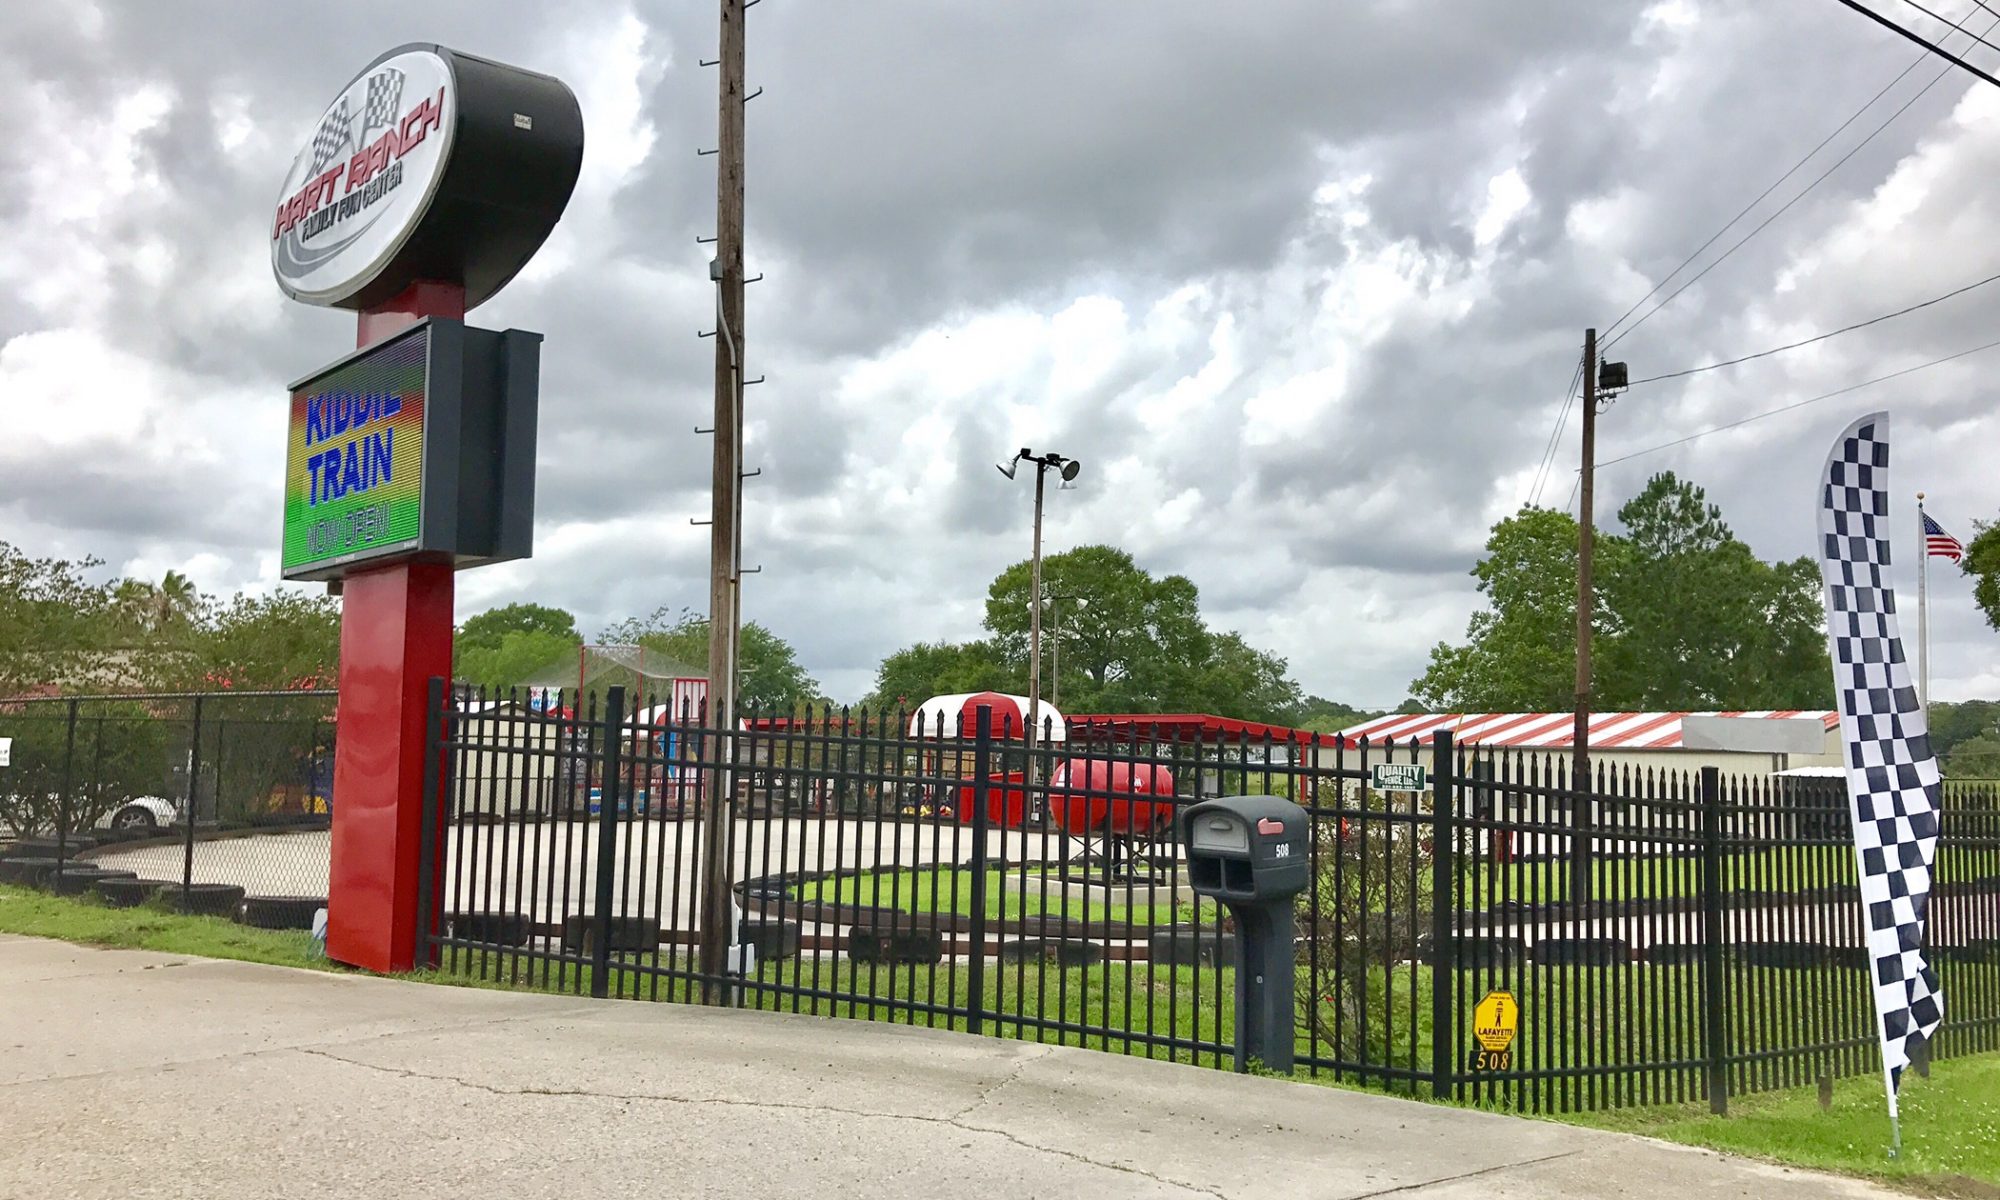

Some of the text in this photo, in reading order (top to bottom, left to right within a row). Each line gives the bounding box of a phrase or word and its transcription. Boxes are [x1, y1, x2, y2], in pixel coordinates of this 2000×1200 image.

[273, 86, 445, 240] HART RANCH
[302, 160, 403, 243] FAMILY FUN CENTER
[306, 425, 394, 508] TRAIN
[306, 517, 342, 555] NOW
[1378, 765, 1420, 780] QUALITY
[1276, 844, 1289, 857] 508
[1478, 1028, 1513, 1036] LAFAYETTE
[1476, 1051, 1509, 1070] 508
